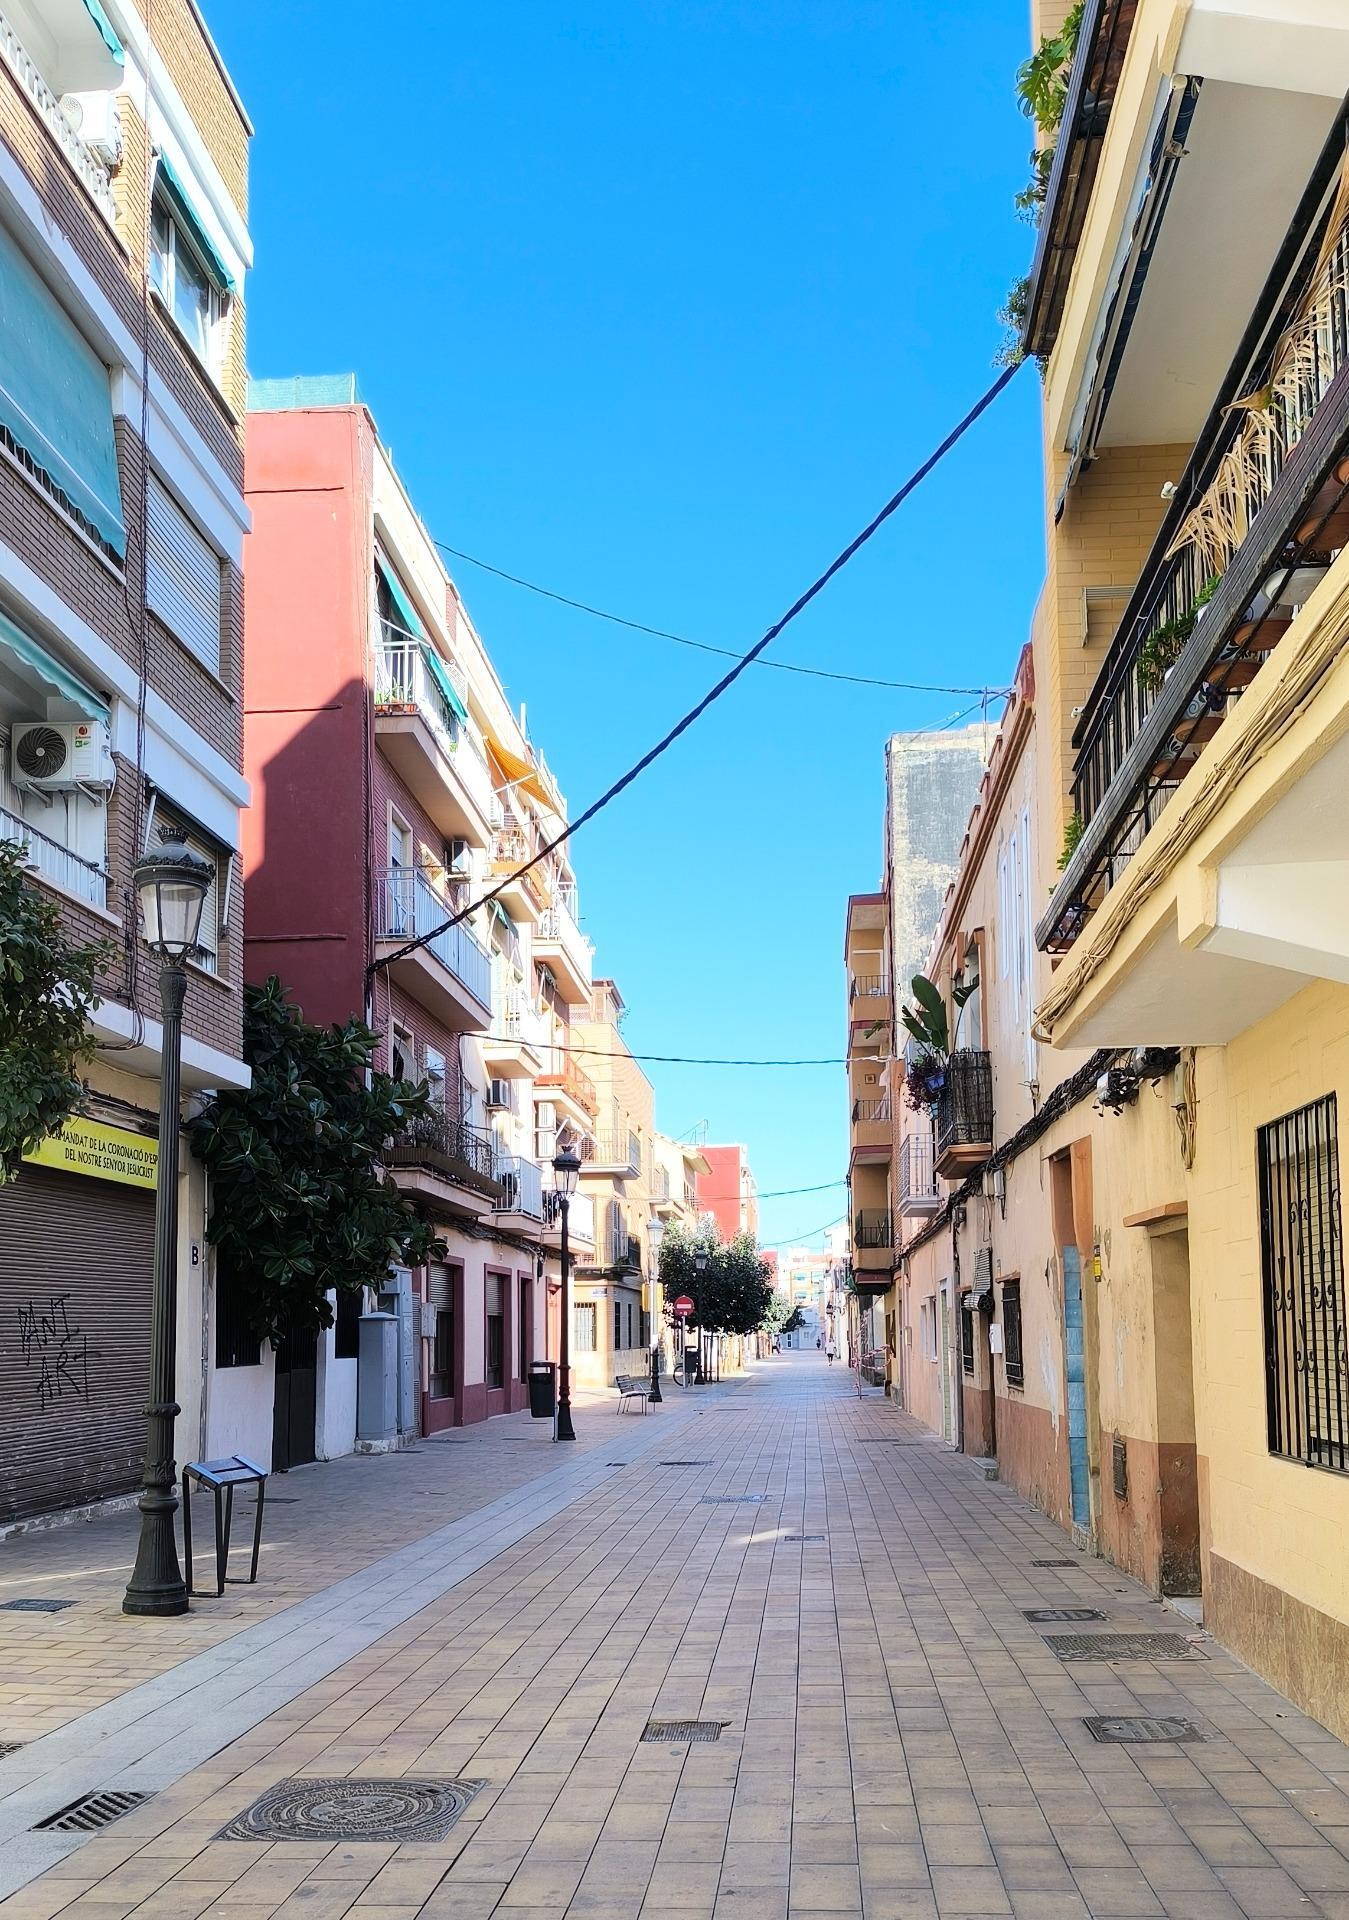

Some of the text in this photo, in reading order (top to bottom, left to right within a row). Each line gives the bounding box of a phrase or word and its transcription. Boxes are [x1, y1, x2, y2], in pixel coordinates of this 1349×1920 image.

[65, 1147, 154, 1179] DEL NOSTRE SENYOR JESUCRIST
[89, 1137, 97, 1150] DE
[98, 1139, 107, 1153] LA
[107, 1142, 143, 1161] CORONACIÓ
